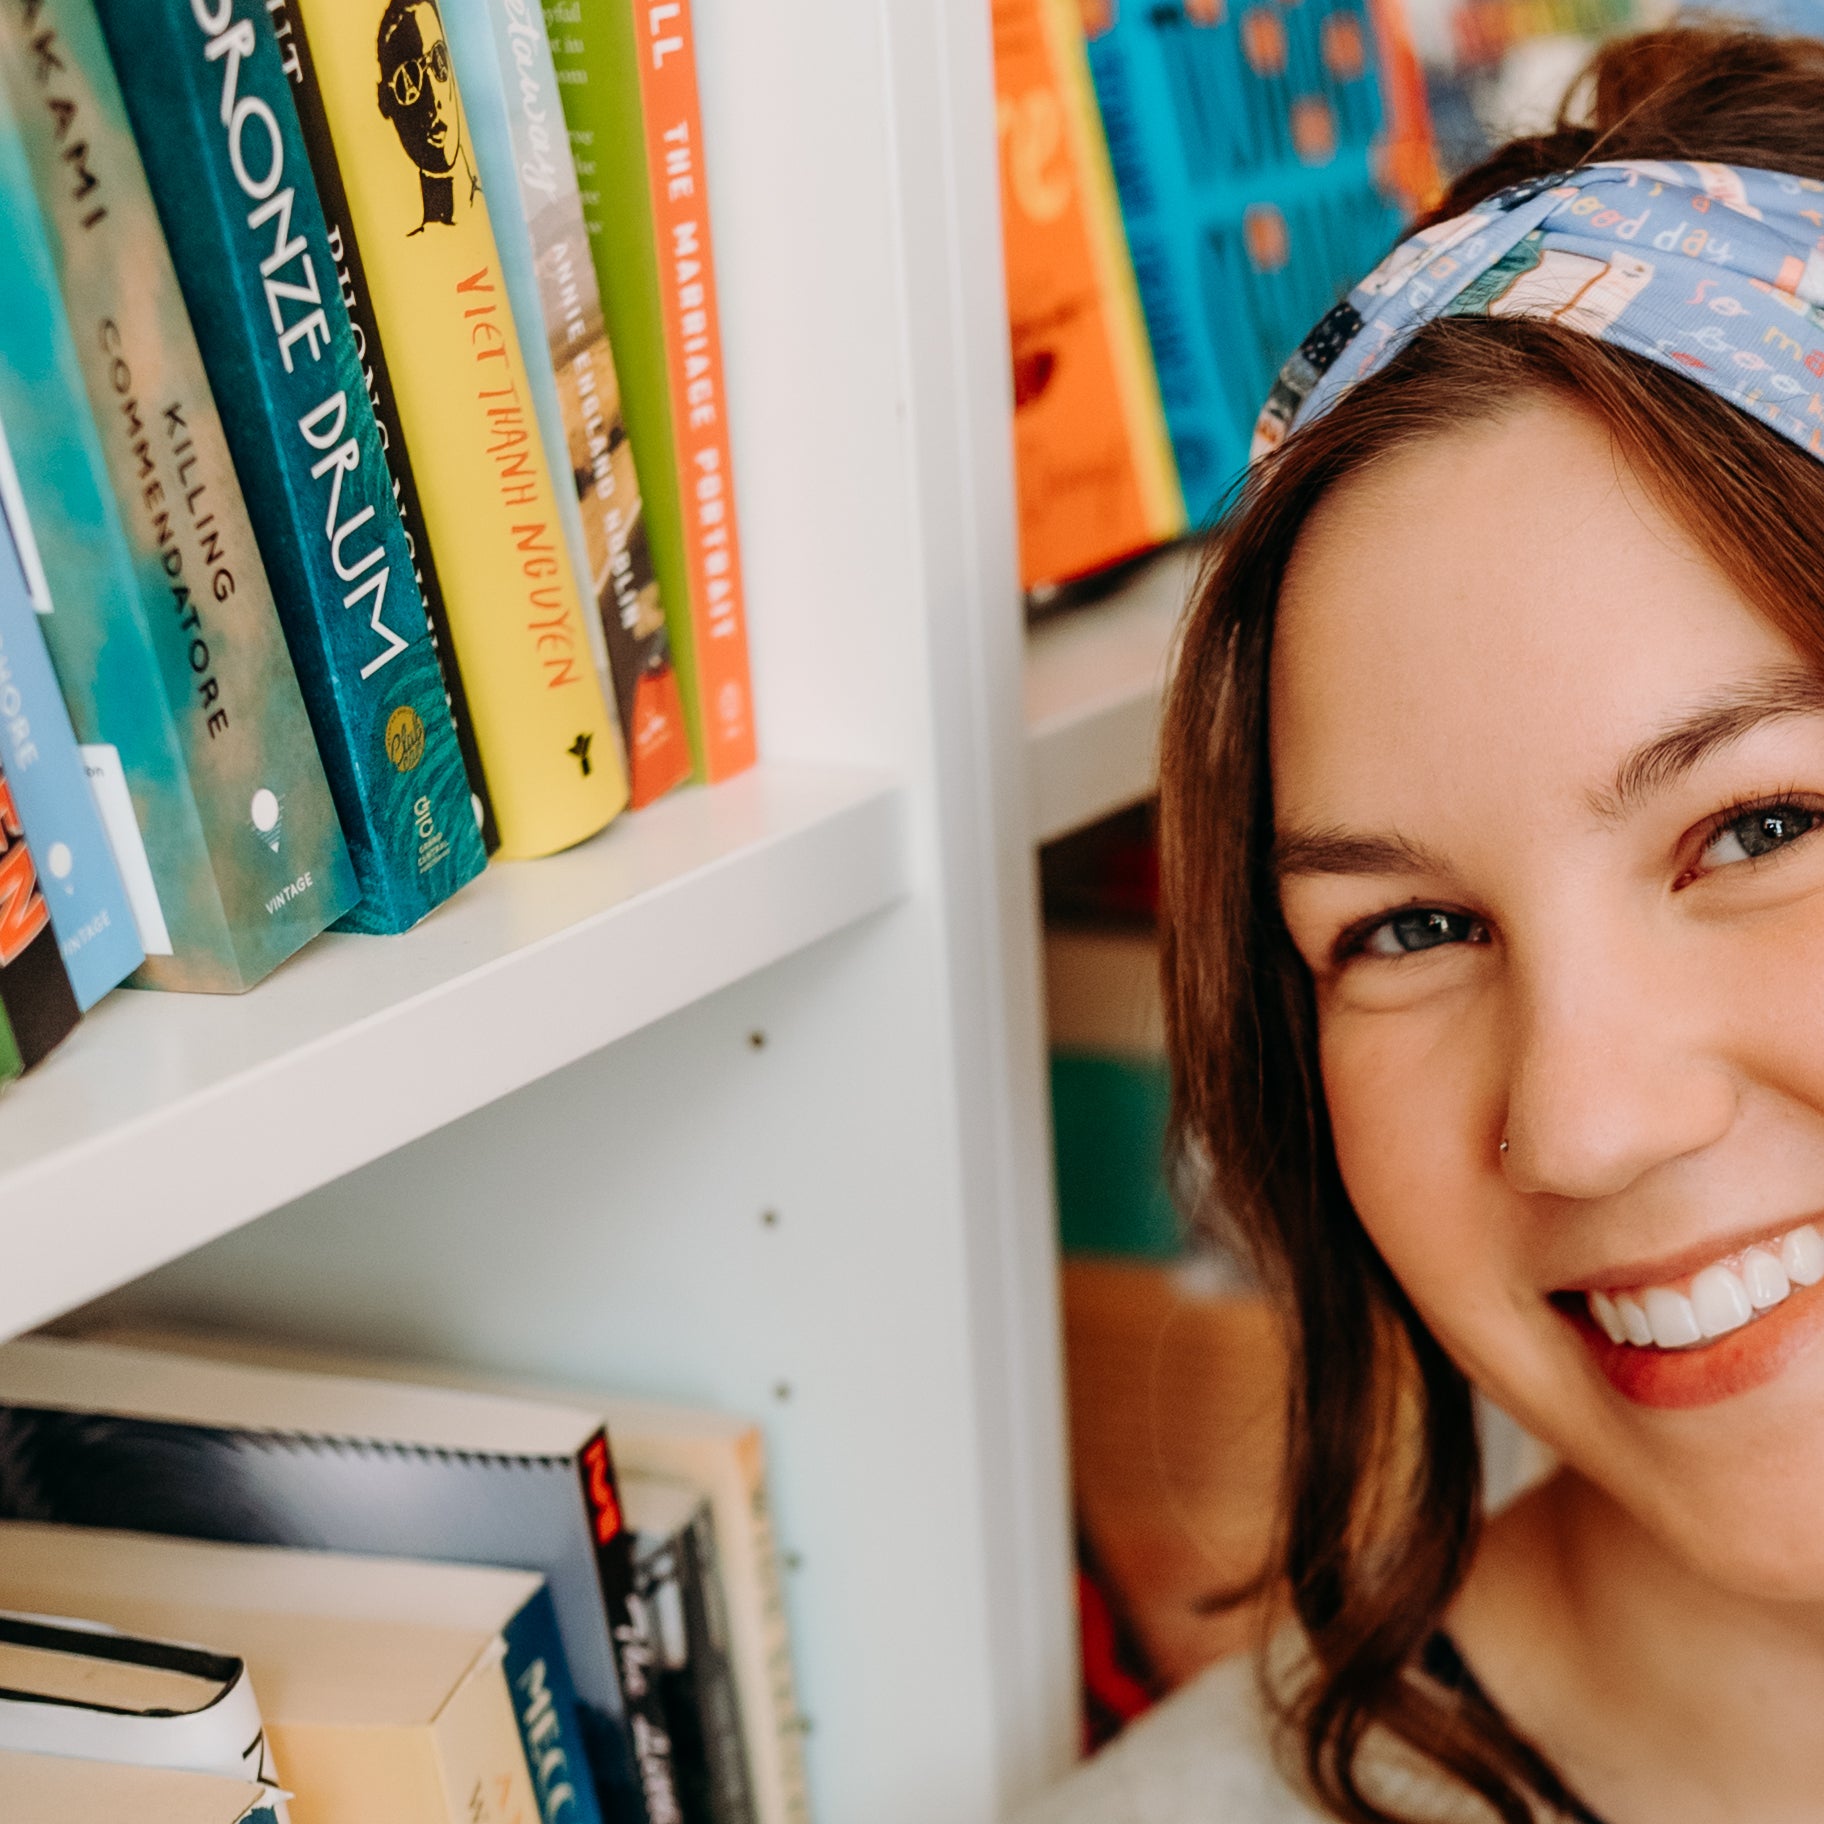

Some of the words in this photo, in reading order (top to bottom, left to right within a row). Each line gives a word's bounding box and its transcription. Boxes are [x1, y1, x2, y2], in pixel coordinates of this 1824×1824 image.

[663, 119, 694, 203] THE
[1652, 220, 1736, 264] day
[456, 266, 510, 370] VIET
[551, 241, 587, 344] ANNIE
[570, 350, 616, 499] ENGLAND
[672, 220, 717, 429] MARRIAGE
[100, 317, 229, 740] COMMENDATORE
[162, 402, 236, 603] KILLING
[478, 381, 540, 506] THANH
[299, 390, 409, 680] DRUM
[511, 522, 583, 691] NGUYEN
[694, 446, 737, 640] PORTRAIT
[264, 870, 314, 916] VINTAGE
